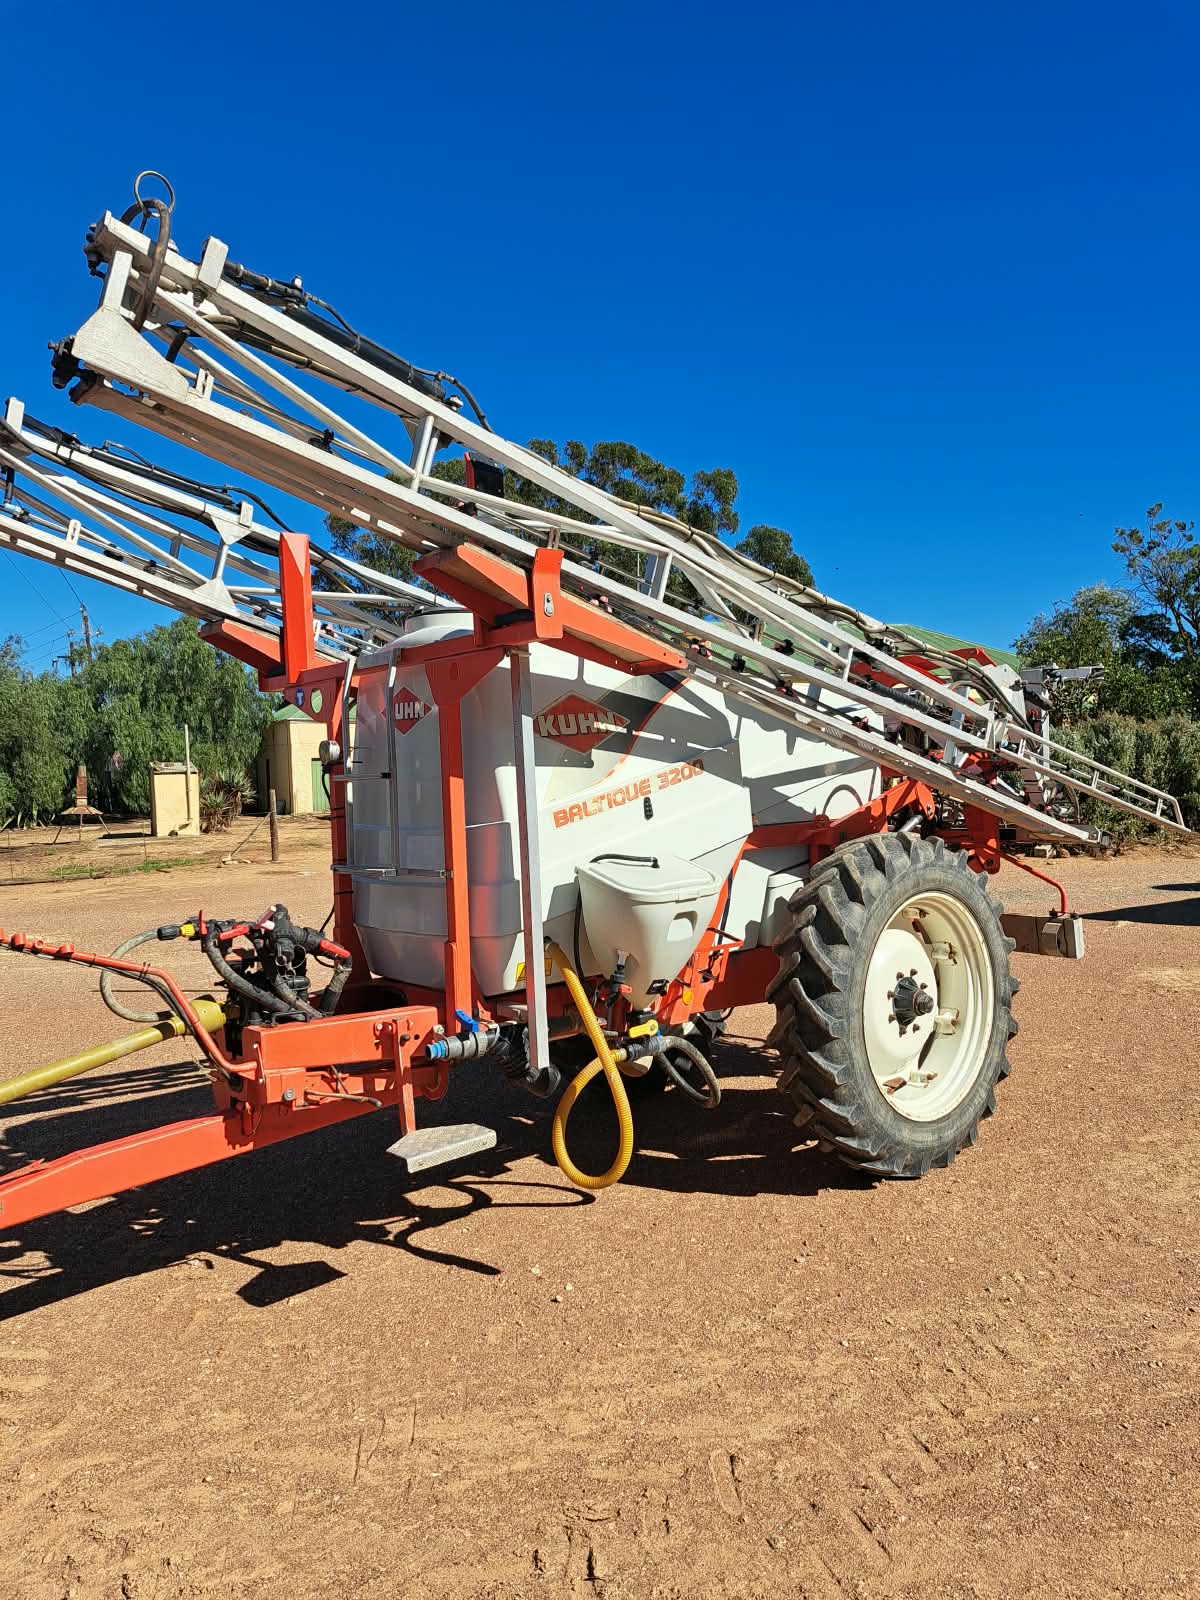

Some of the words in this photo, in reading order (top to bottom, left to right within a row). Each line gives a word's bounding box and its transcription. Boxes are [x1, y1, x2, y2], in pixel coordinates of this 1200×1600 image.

[393, 701, 425, 720] UHN
[538, 711, 616, 737] KUHN
[553, 778, 652, 828] BALTIQUE
[656, 758, 705, 790] 3200
